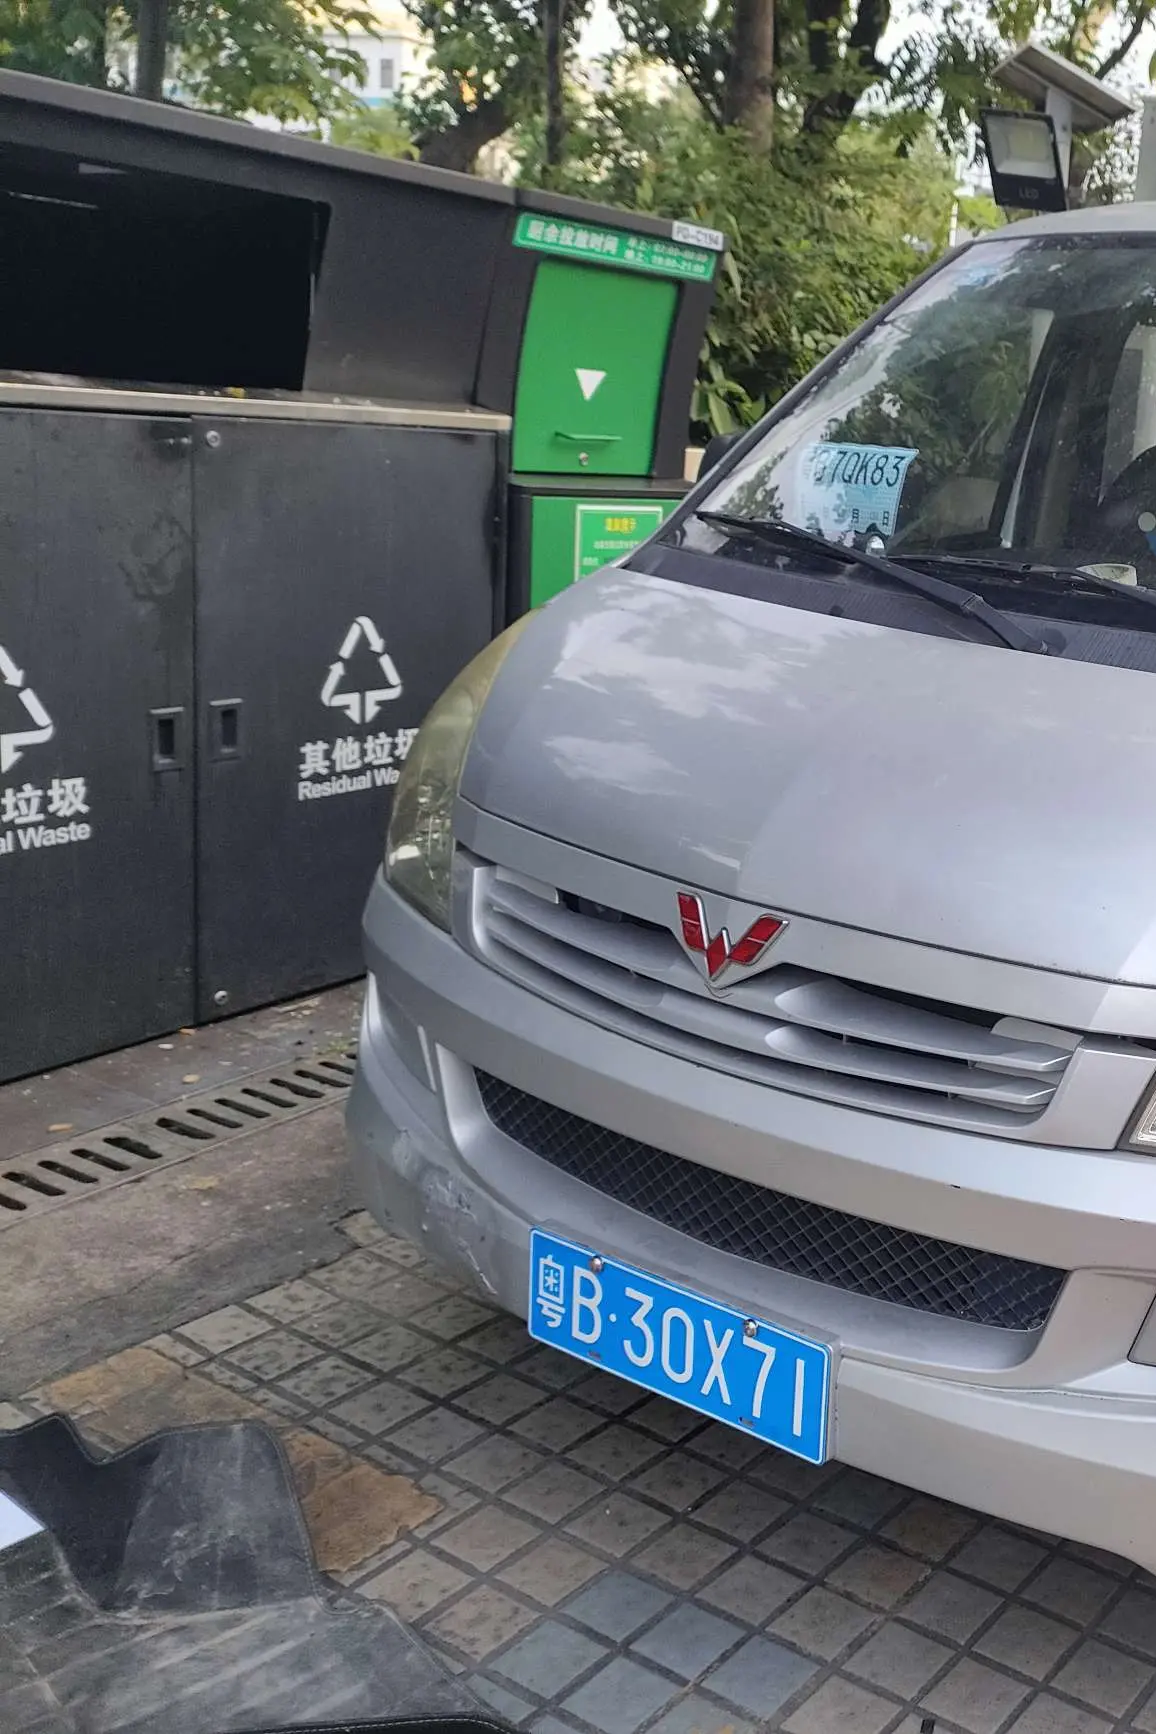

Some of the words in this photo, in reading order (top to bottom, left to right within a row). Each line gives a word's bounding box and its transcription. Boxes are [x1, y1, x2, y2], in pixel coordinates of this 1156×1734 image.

[0, 776, 91, 825] 垃圾
[298, 769, 372, 801] Residual
[17, 821, 91, 850] Waste
